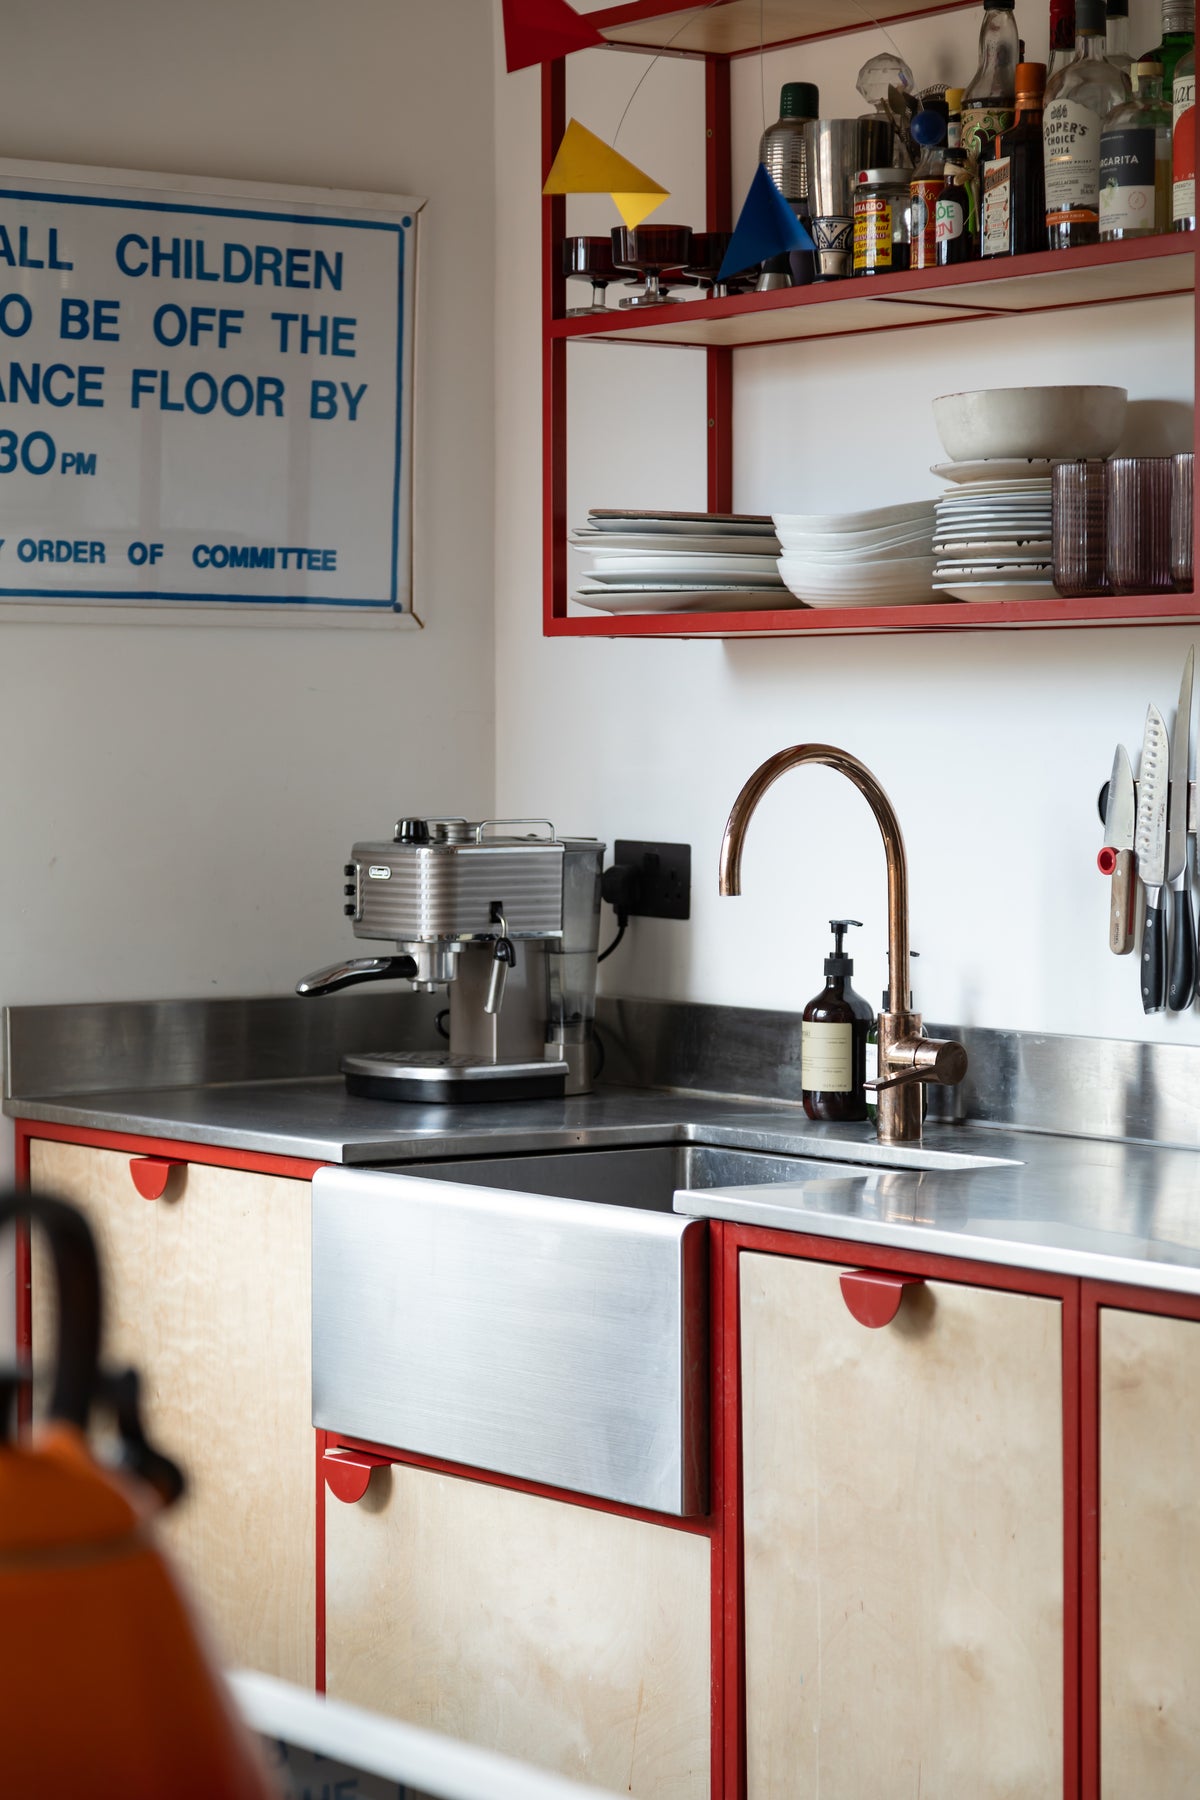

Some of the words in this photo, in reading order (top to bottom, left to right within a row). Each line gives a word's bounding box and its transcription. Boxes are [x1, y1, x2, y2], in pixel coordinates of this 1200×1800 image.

[1047, 134, 1076, 146] CHOICE
[1050, 146, 1070, 156] 2014
[115, 233, 343, 291] CHILDREN
[59, 297, 121, 343] BE
[152, 303, 245, 349] OFF
[271, 312, 357, 358] THE
[0, 361, 106, 408] NCE
[131, 368, 286, 417] FLOOR
[309, 379, 368, 422] BY
[16, 537, 107, 565] ORDER
[127, 540, 165, 567] OF
[191, 543, 337, 573] COMMITTEE
